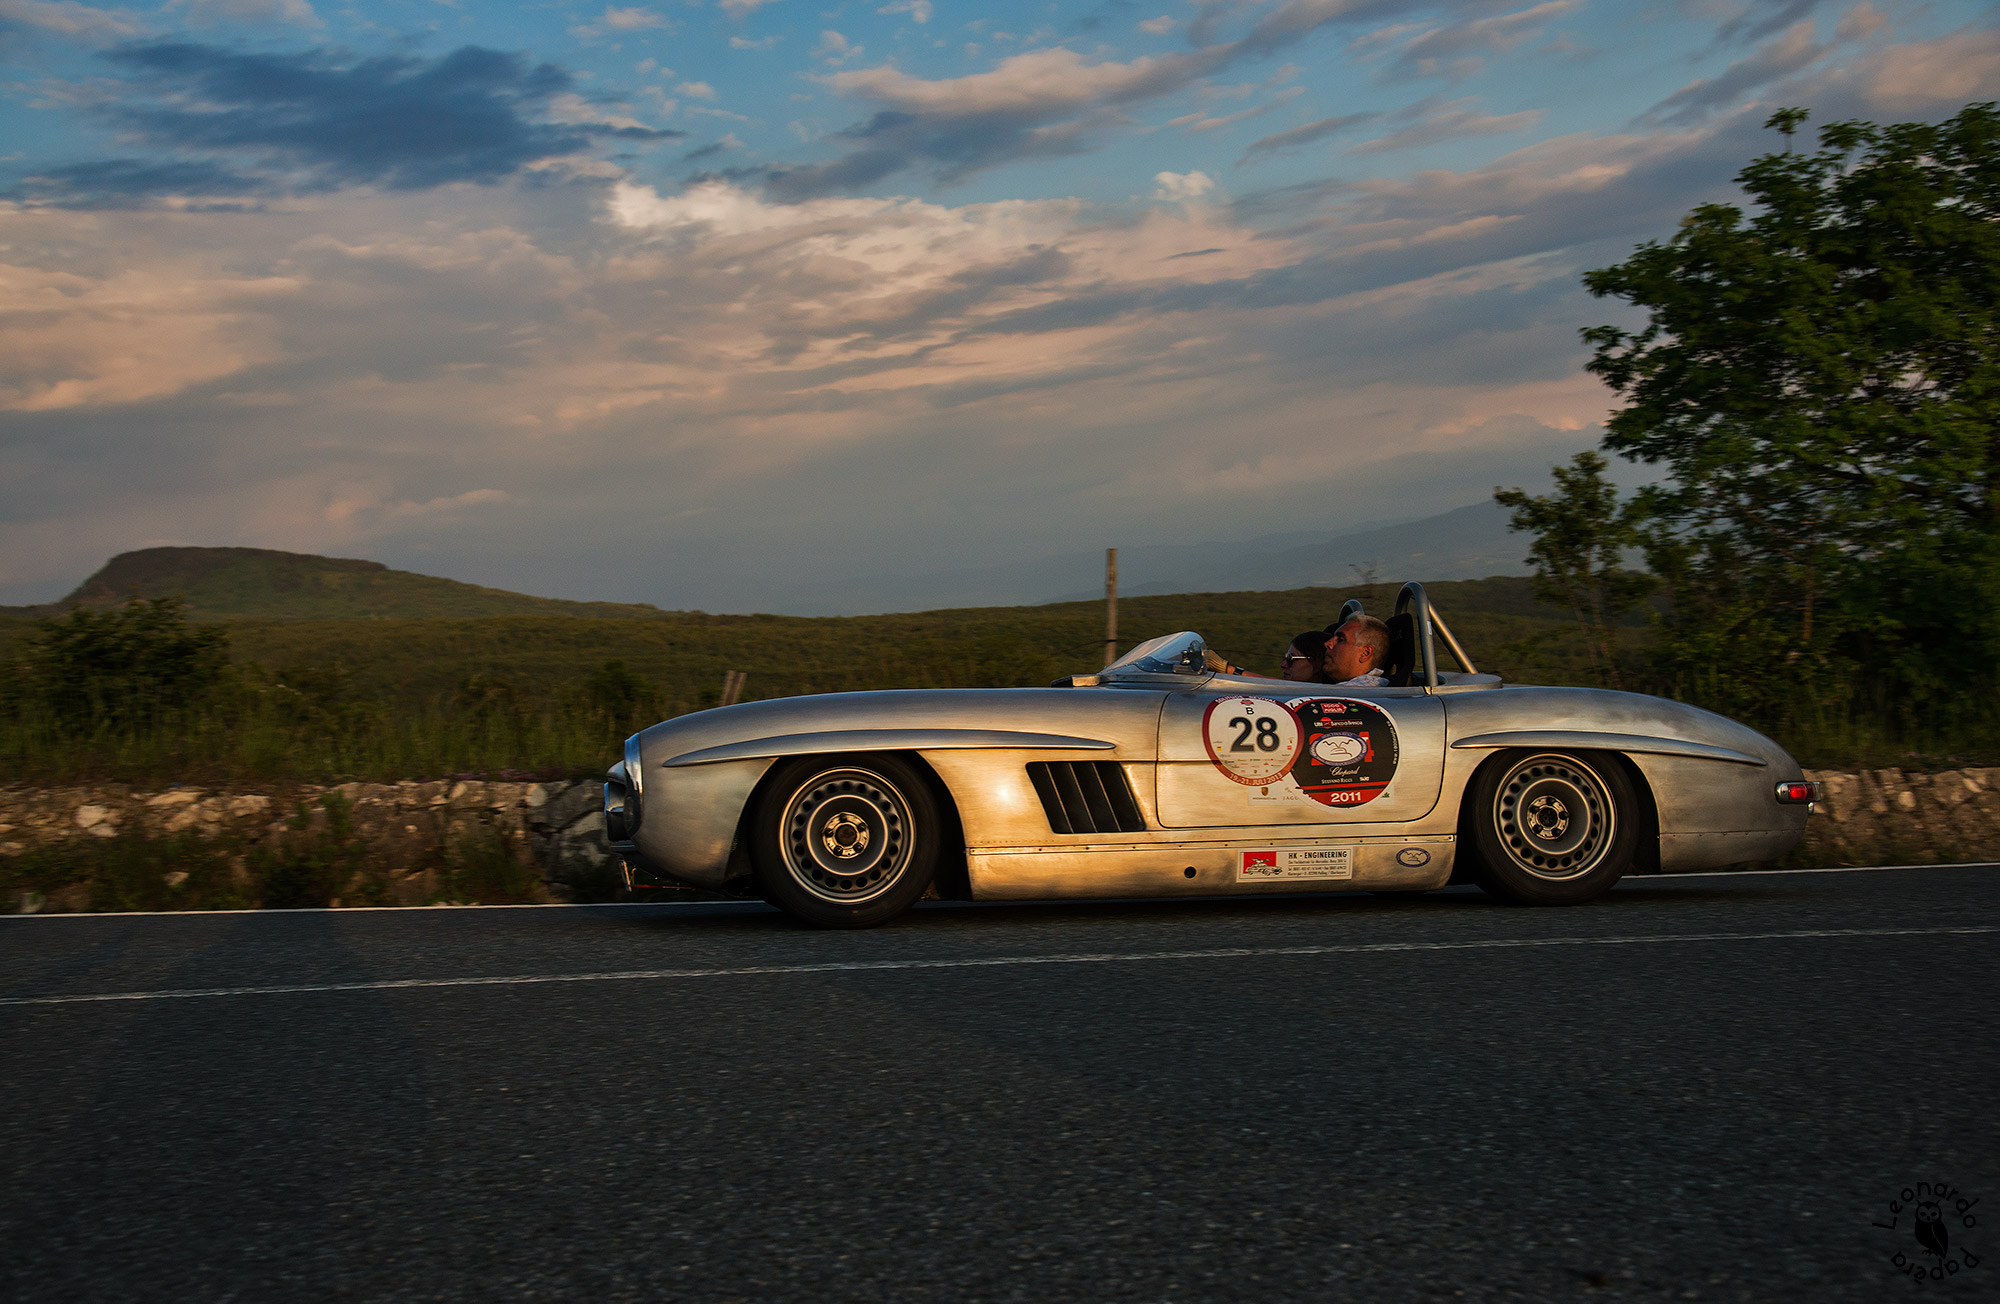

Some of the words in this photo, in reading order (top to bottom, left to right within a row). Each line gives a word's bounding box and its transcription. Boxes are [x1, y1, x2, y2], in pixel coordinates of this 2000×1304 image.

[1245, 707, 1255, 715] B
[1228, 716, 1280, 753] 28
[1329, 766, 1360, 777] Chopard
[1267, 772, 1283, 783] 2013
[1330, 791, 1361, 803] 2011
[1304, 851, 1347, 859] ENGINEERING
